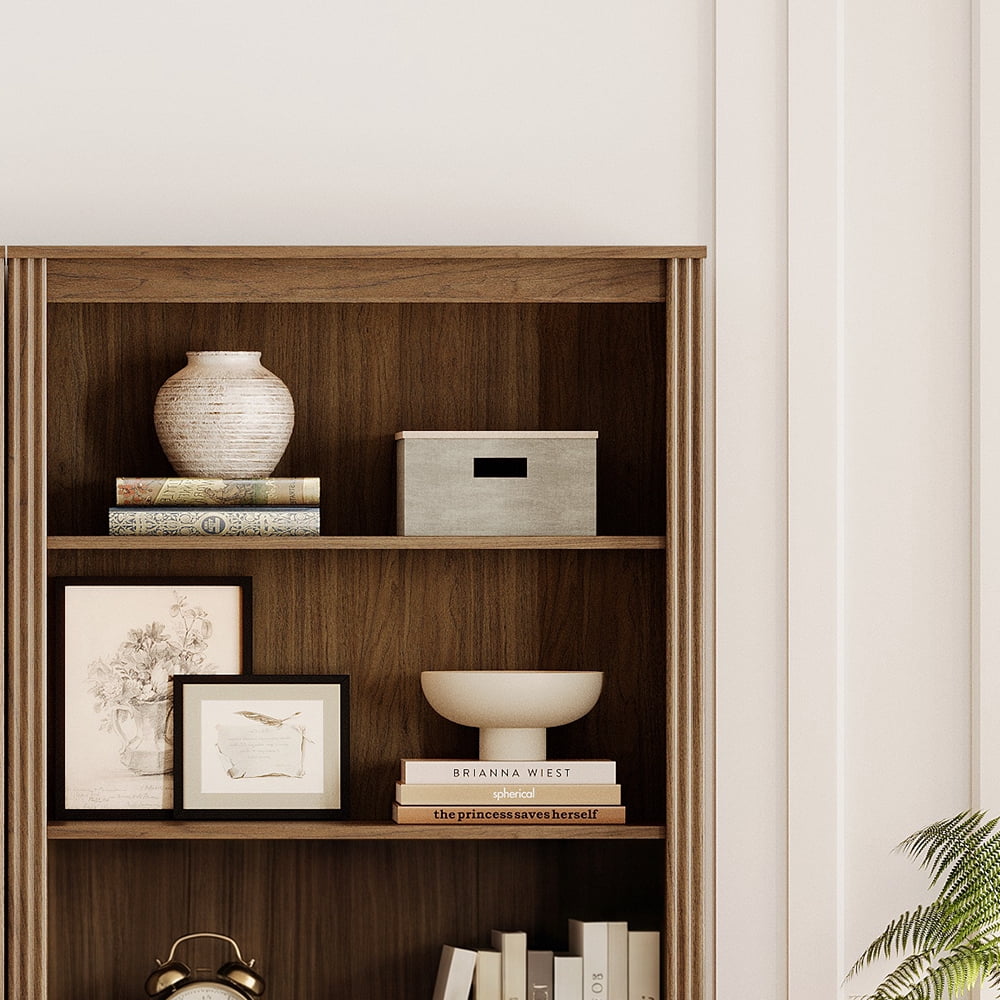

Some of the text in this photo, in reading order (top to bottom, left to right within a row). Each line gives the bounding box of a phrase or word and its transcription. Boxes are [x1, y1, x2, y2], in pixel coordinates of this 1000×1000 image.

[453, 768, 571, 778] BRIANNA WIEST
[492, 787, 535, 800] spherical
[433, 809, 599, 822] the princess saves herself
